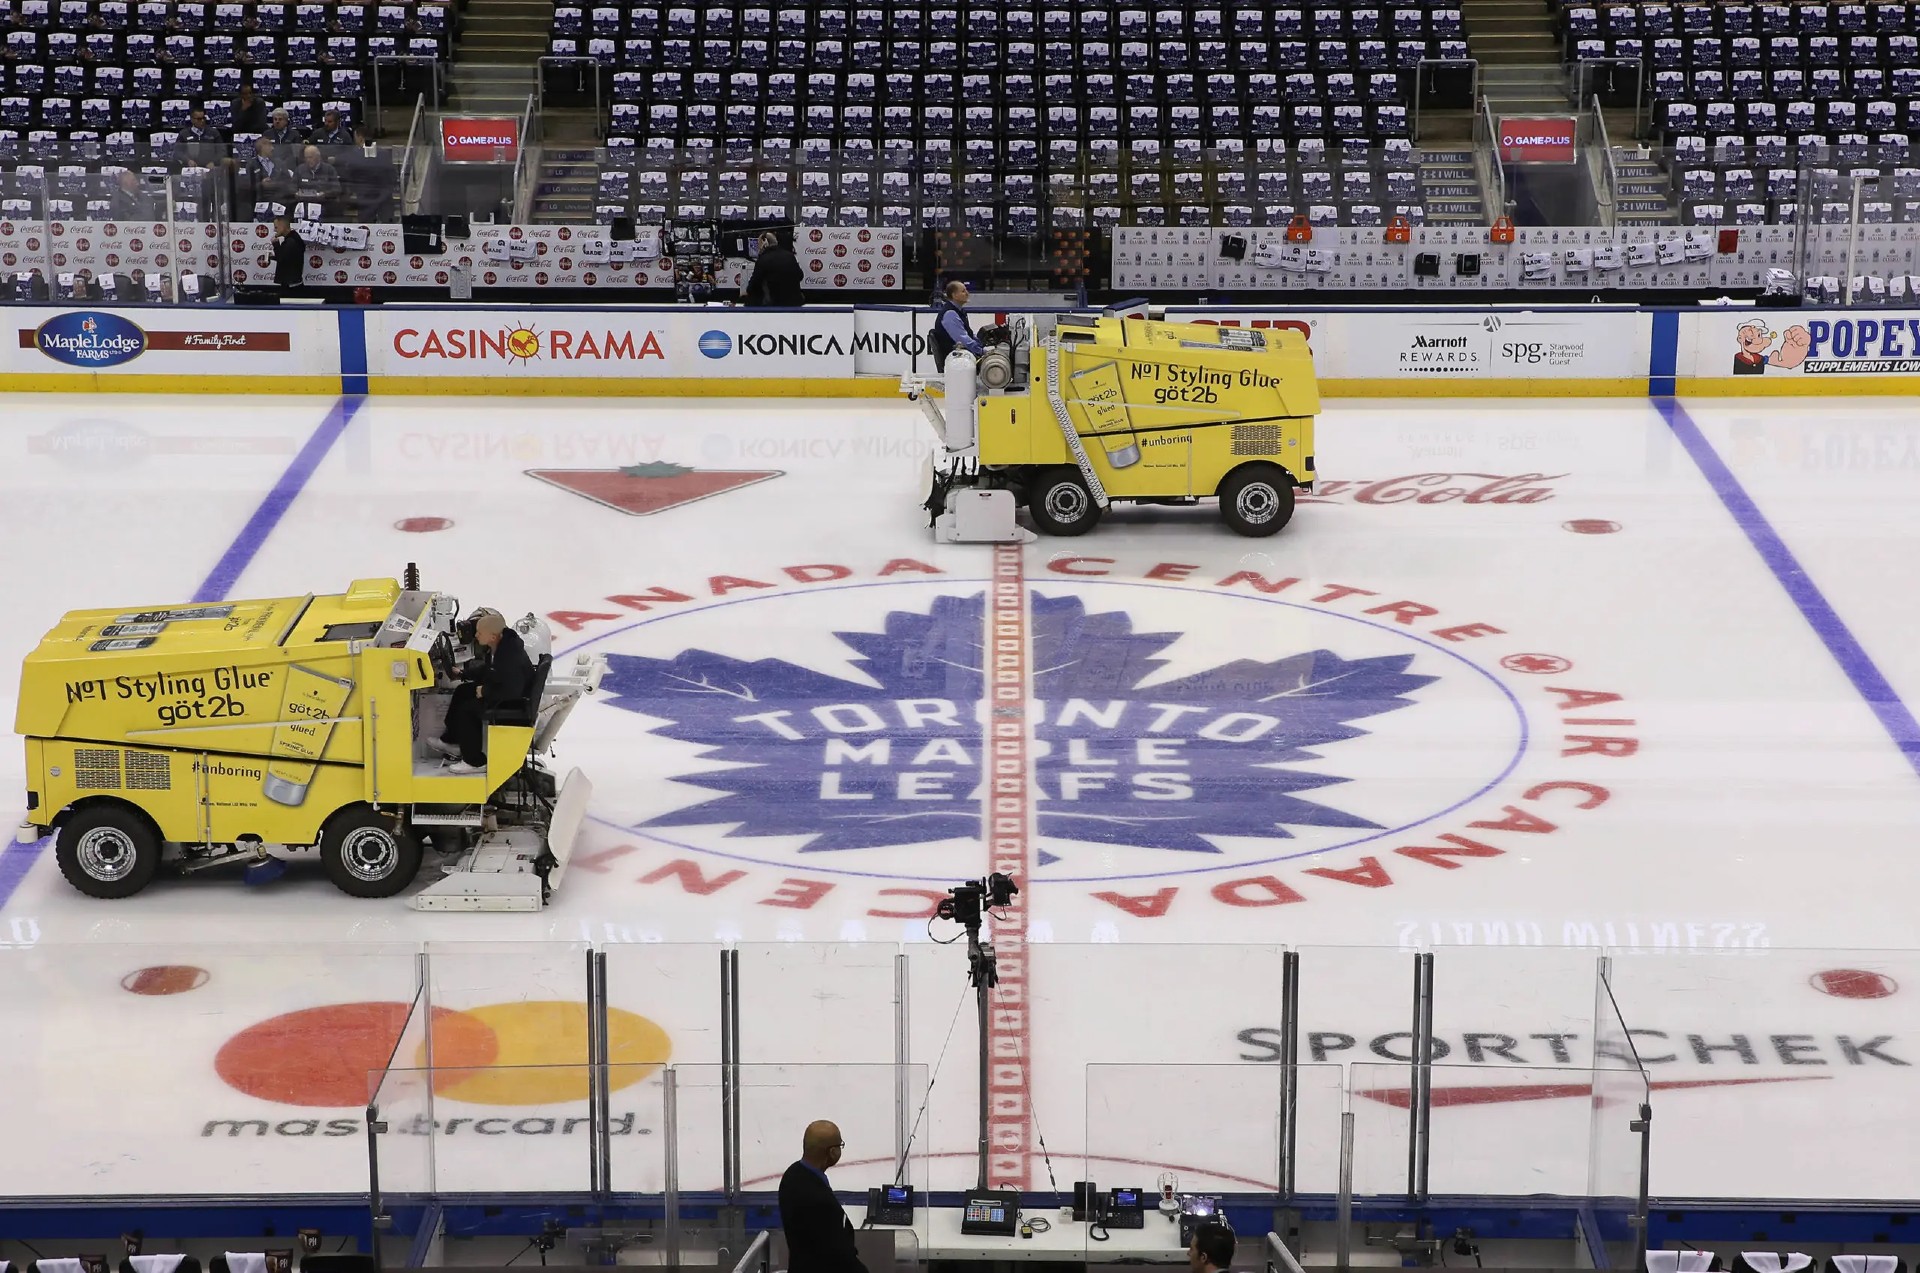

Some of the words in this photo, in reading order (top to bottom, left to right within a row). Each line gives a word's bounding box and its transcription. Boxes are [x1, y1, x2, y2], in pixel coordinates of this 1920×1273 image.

[184, 335, 247, 350] #FamilyFirst
[550, 330, 665, 360] RAMA
[738, 333, 844, 355] KONICA
[850, 331, 935, 357] MINOL
[1411, 335, 1468, 348] Marriott
[1549, 343, 1584, 351] Starwood
[1549, 350, 1584, 358] Preferred
[76, 350, 109, 360] FARMS
[1549, 358, 1570, 366] Guest
[1805, 361, 1893, 373] SUPPLEMENTS
[1167, 364, 1232, 389] Styling
[1154, 385, 1218, 404] göt2b
[548, 557, 947, 642] ANADA
[1046, 556, 1509, 643] CENTRE
[115, 672, 206, 702] Styling
[157, 693, 245, 726] göt2b
[732, 697, 1281, 744] TORNTO
[1237, 1027, 1578, 1064] SPORT
[201, 1111, 637, 1137] masrcard
